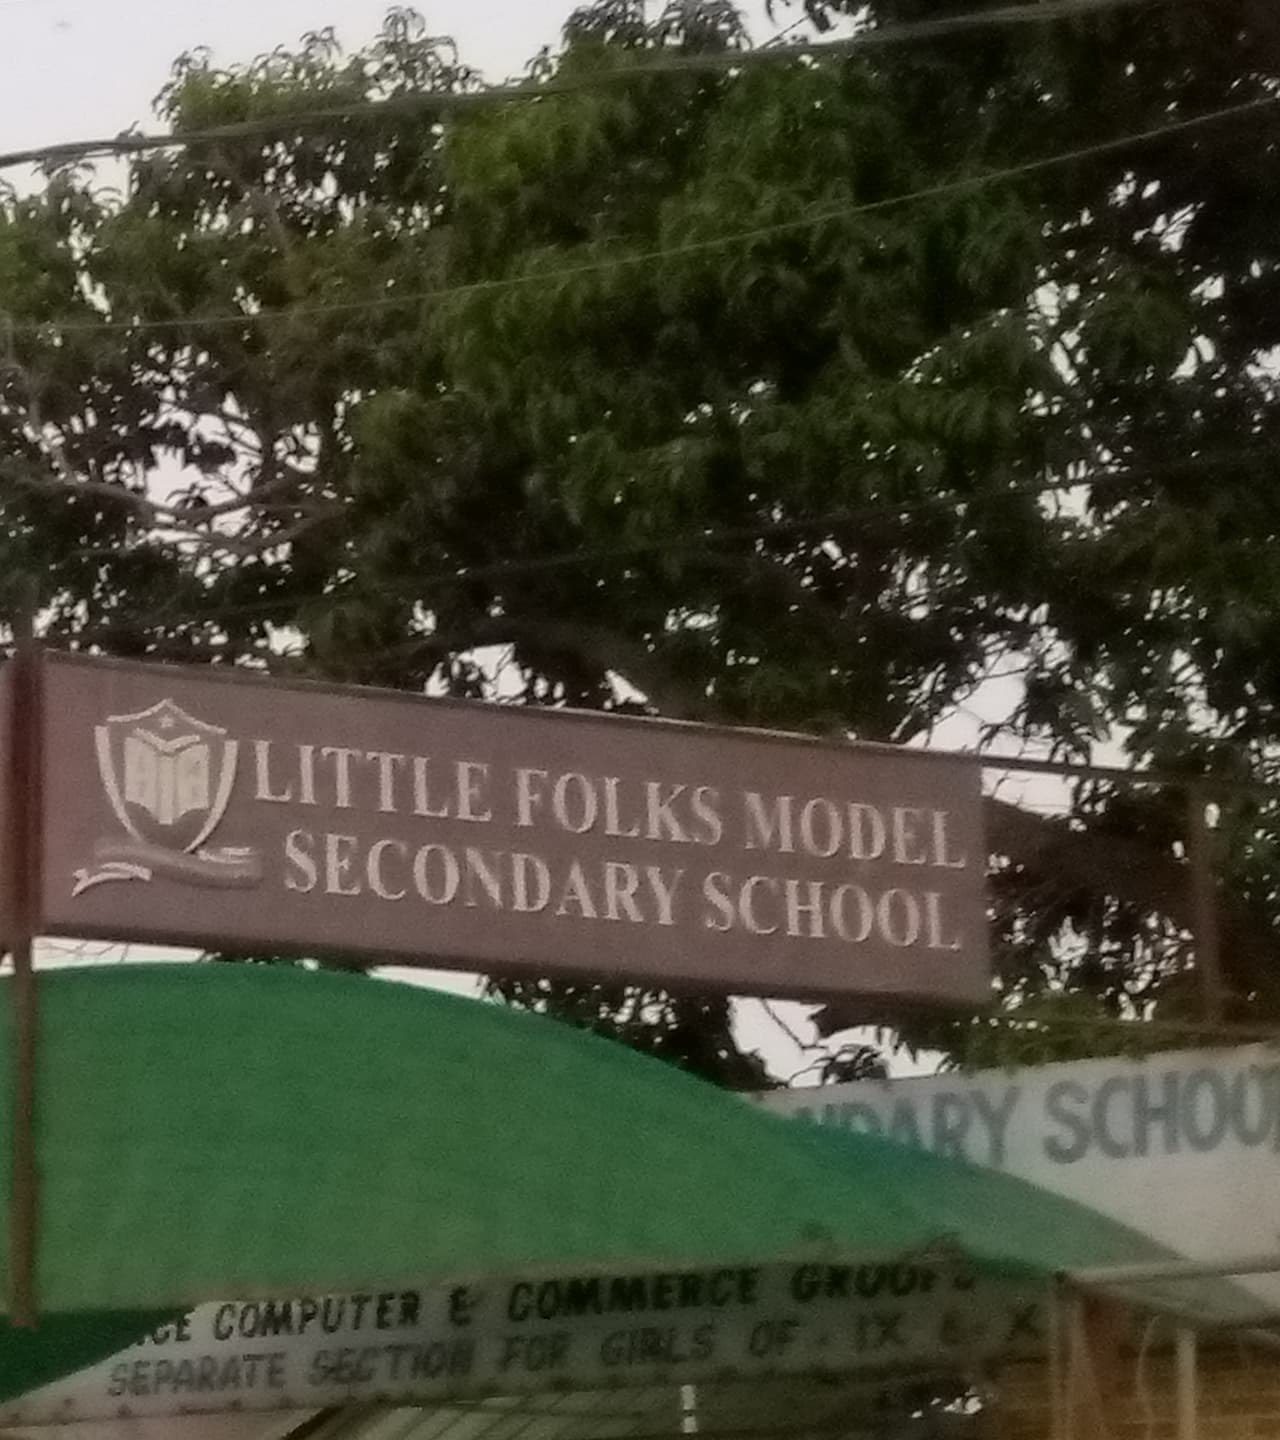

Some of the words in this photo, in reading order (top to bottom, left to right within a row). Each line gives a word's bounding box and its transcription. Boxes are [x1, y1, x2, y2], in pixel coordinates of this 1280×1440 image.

[254, 739, 493, 823] LITTLE
[517, 766, 722, 850] FOLKS
[745, 794, 968, 871] MODEL
[284, 828, 685, 929] SECONDARY
[702, 871, 963, 952] SCHOOL
[213, 1289, 421, 1342] COMPUTER
[507, 1265, 762, 1323] COMMERCE
[107, 1352, 287, 1397] SEPARATE
[310, 1338, 474, 1387] SECTION
[500, 1330, 572, 1373] FOR
